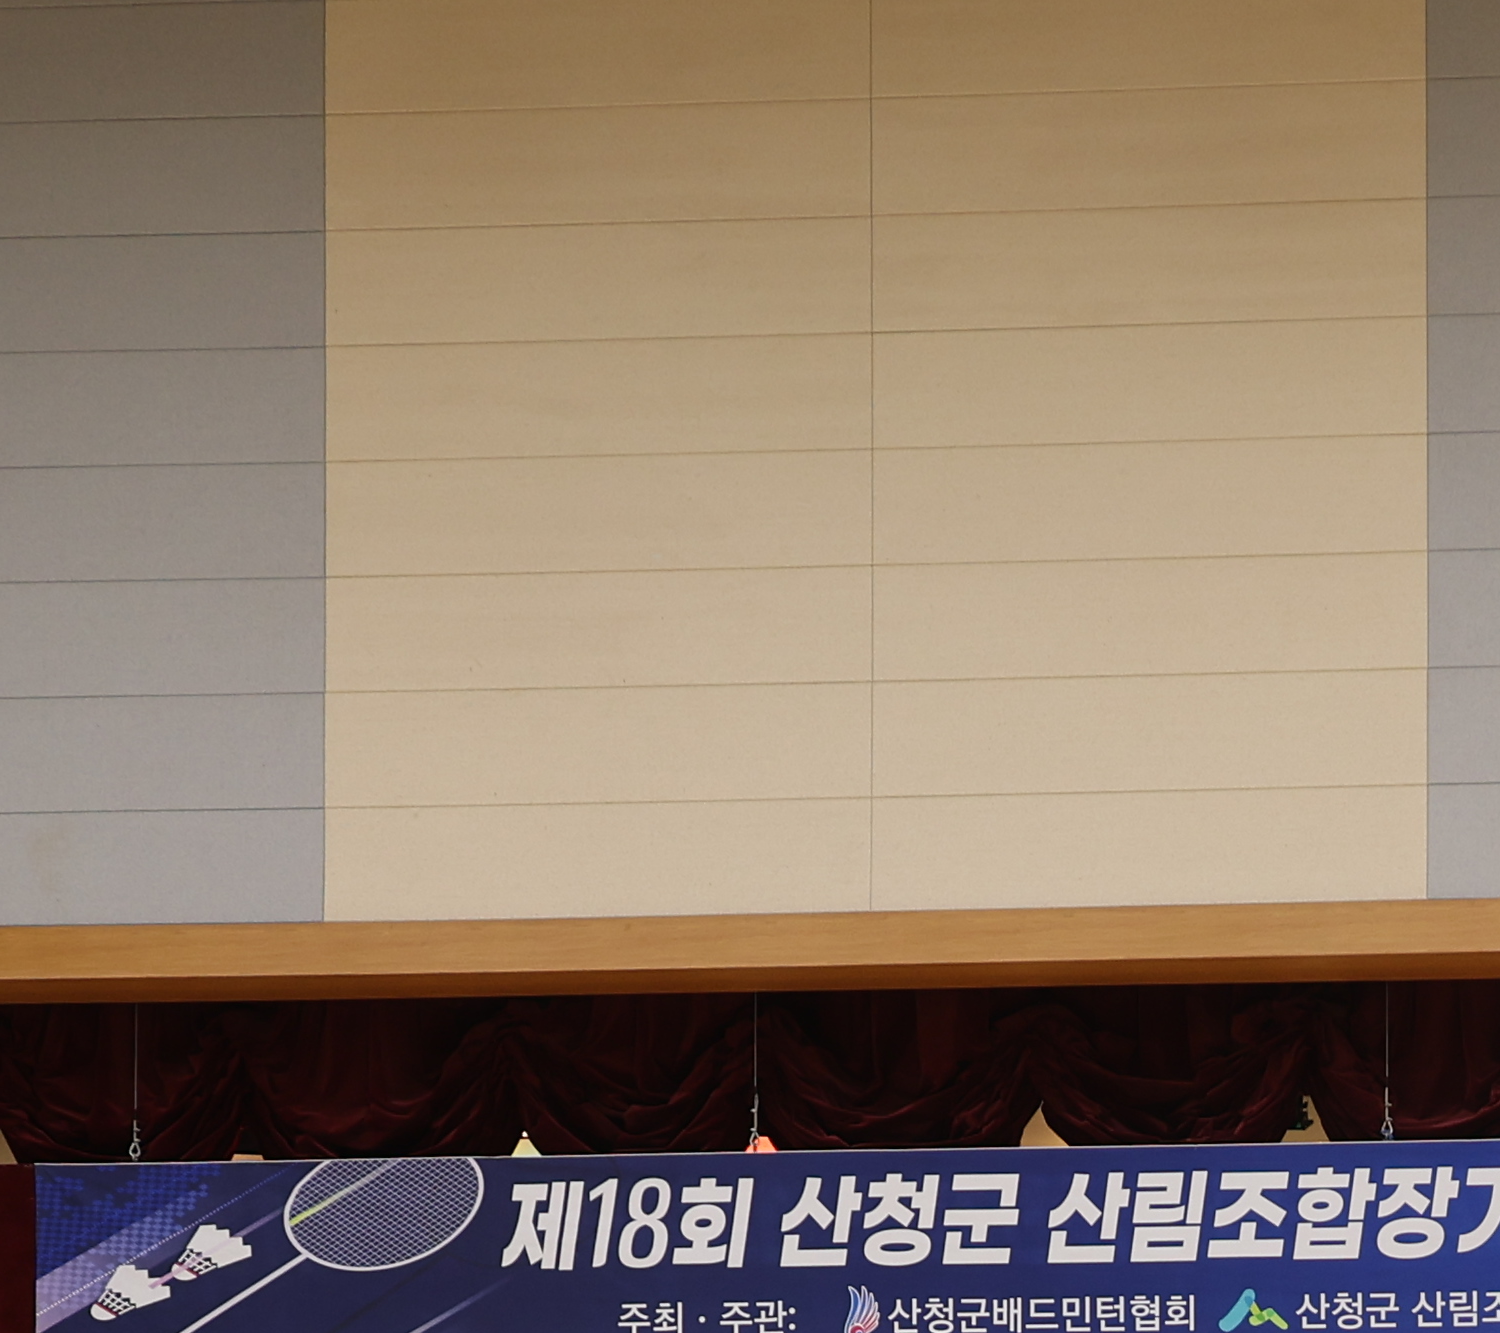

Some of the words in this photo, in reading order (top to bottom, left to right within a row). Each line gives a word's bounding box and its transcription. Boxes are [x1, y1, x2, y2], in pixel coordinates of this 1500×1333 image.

[501, 1177, 754, 1272] 제18회
[780, 1173, 1020, 1268] 산청군
[1295, 1292, 1400, 1329] 산청군
